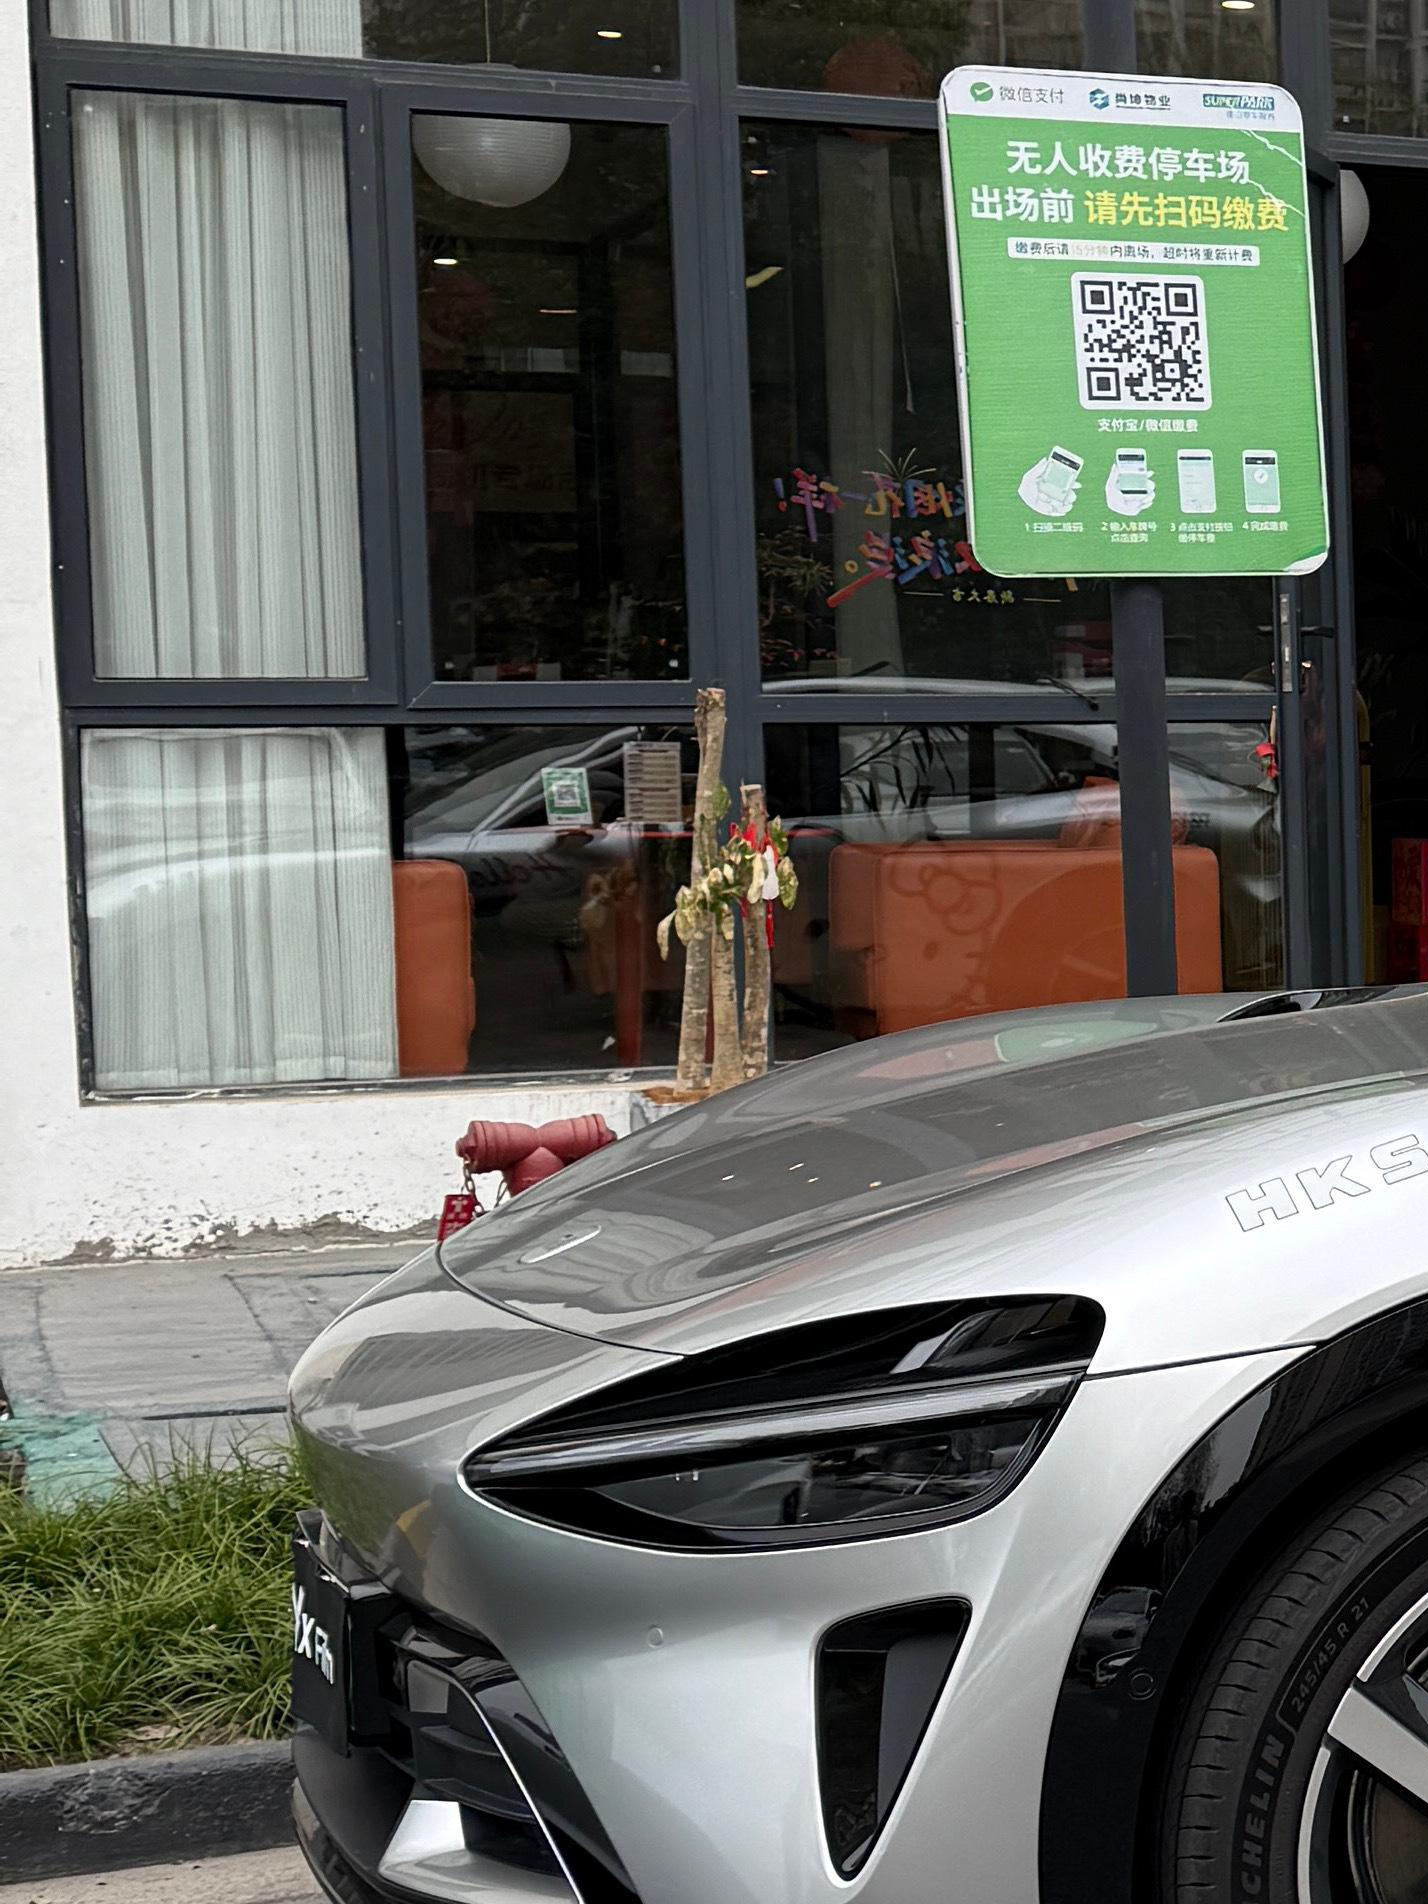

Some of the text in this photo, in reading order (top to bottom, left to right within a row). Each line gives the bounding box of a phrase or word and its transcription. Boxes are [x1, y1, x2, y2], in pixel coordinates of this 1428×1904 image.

[1000, 85, 1064, 104] 微信支付
[1006, 139, 1250, 184] 无人收费停车场
[970, 185, 1289, 232] 出场前 请先扫码缴费
